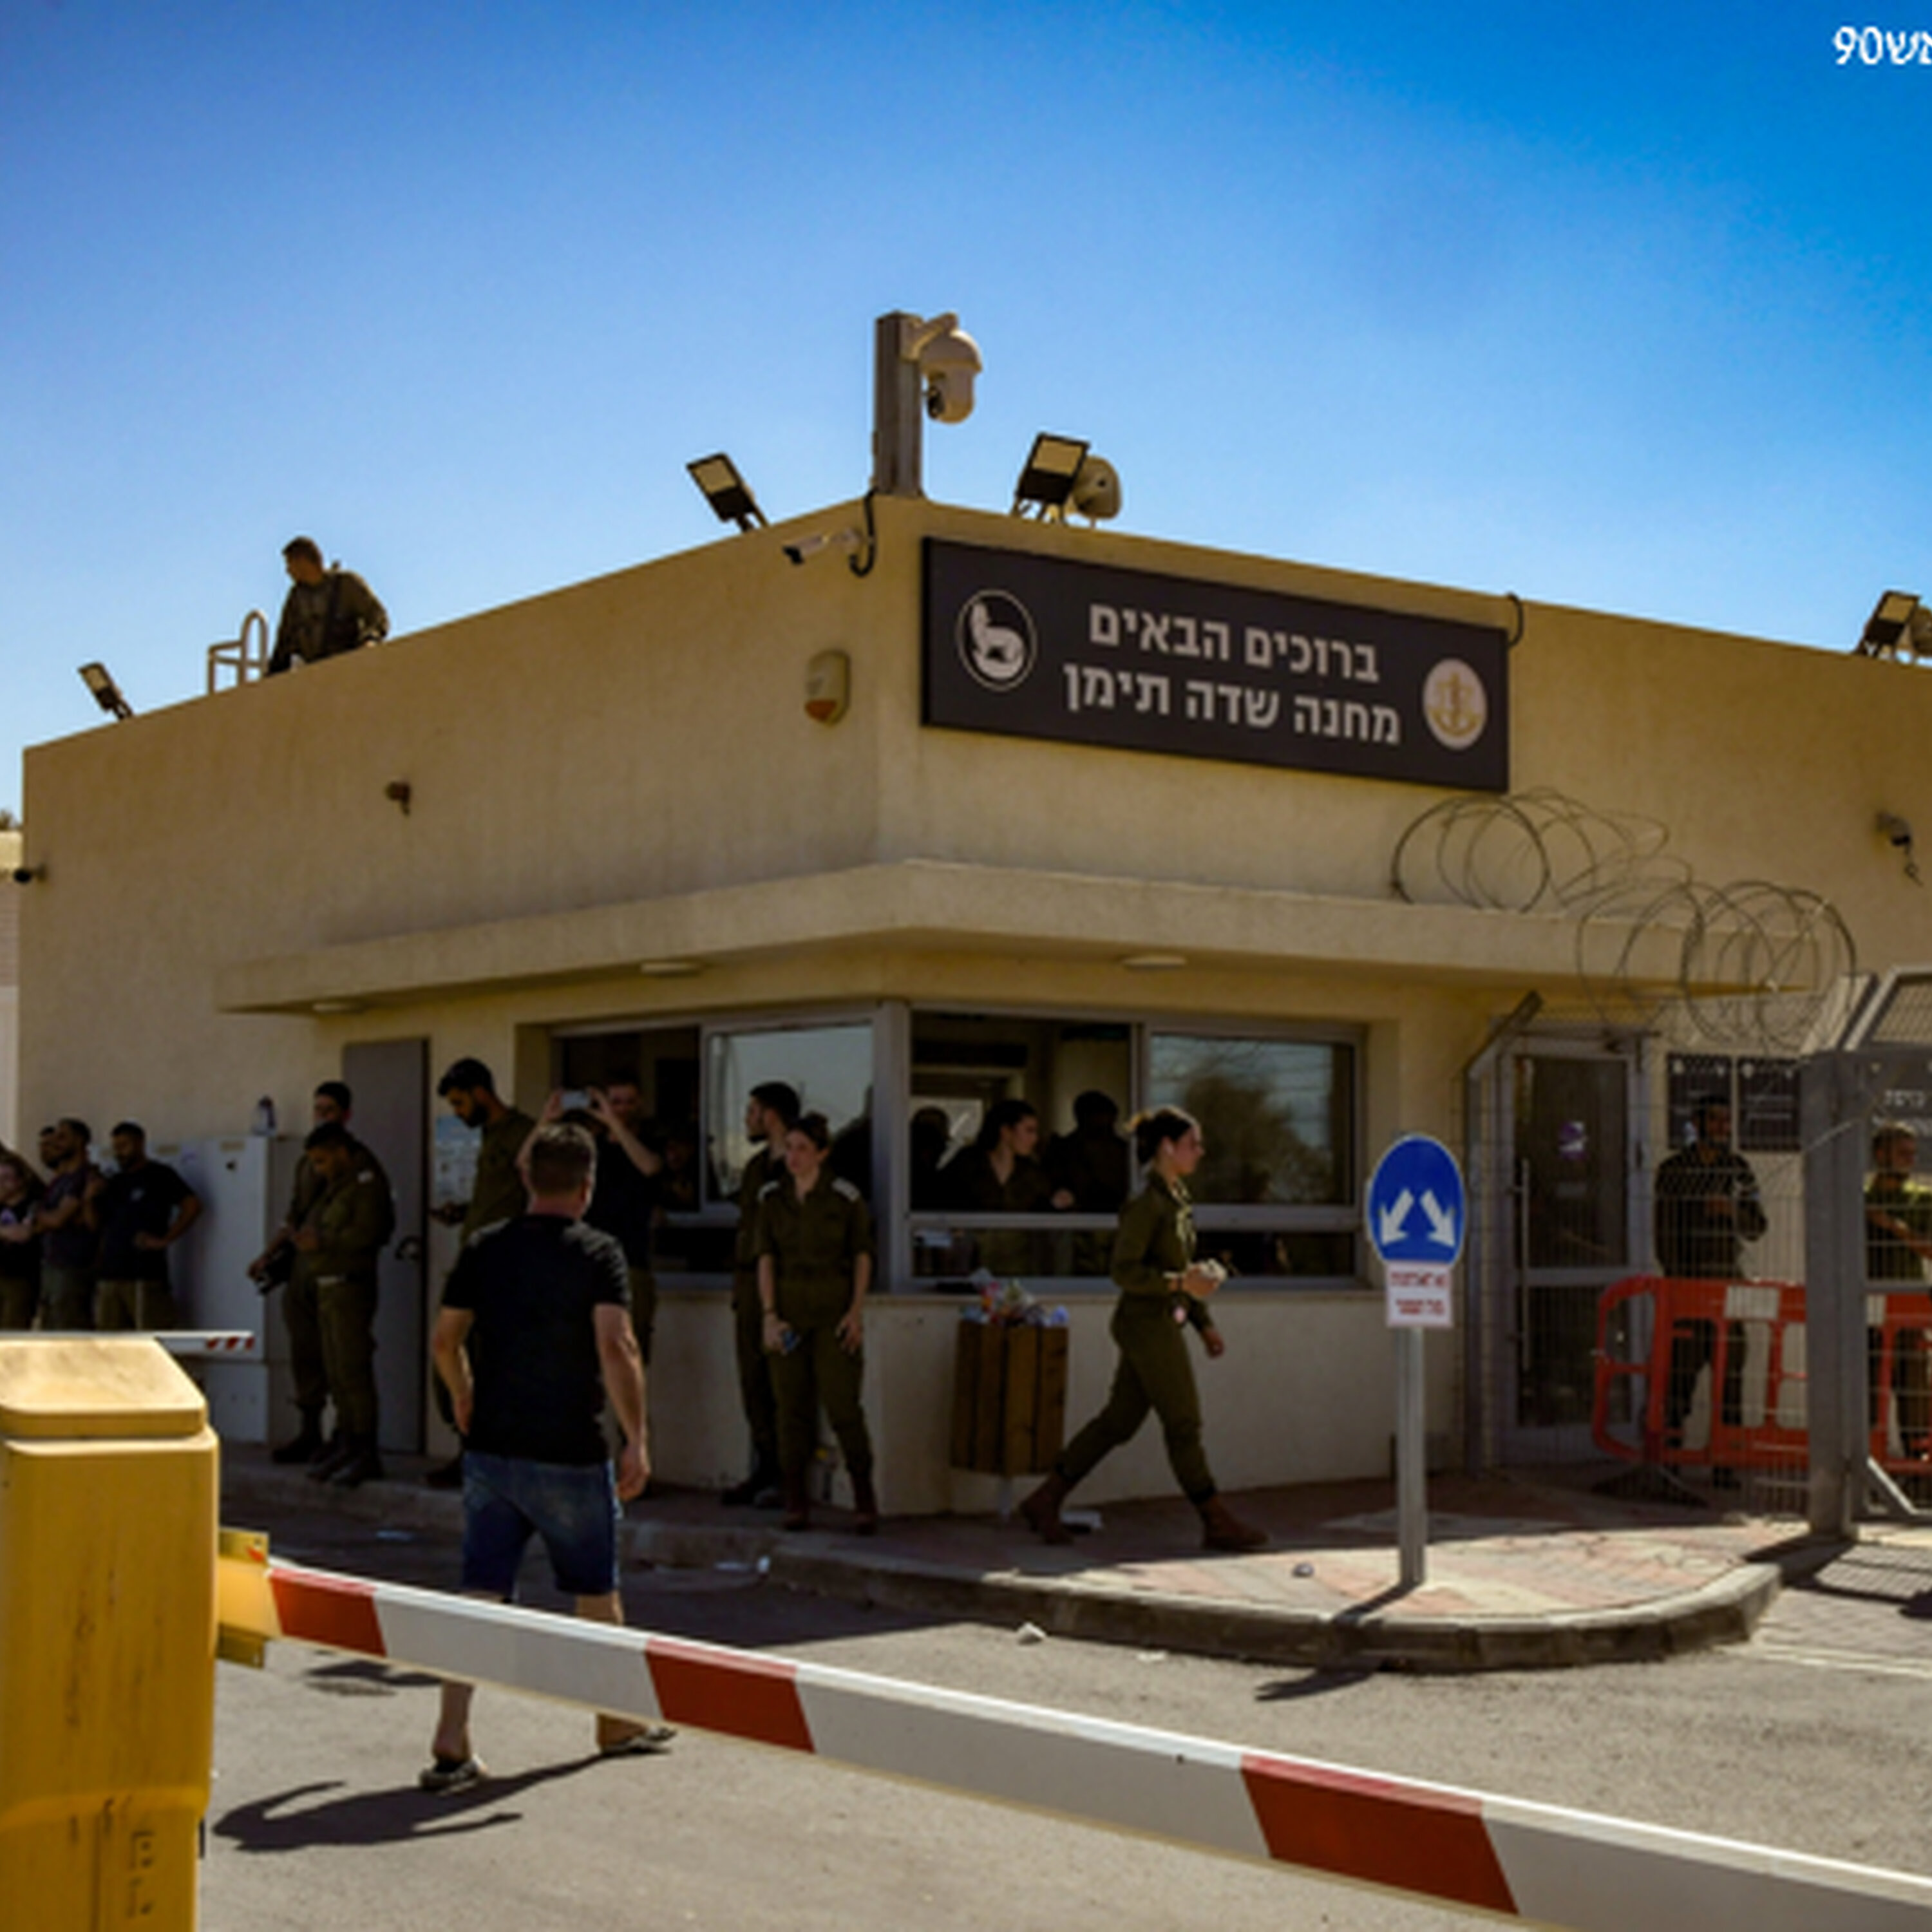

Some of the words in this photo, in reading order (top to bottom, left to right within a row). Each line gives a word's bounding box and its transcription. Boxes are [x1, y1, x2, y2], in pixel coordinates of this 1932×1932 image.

[1090, 604, 1229, 661] הבאים
[1245, 627, 1379, 683] ברוכים
[1063, 663, 1170, 715] תימן
[1186, 680, 1280, 728] שדה
[1294, 696, 1399, 744] מחנה
